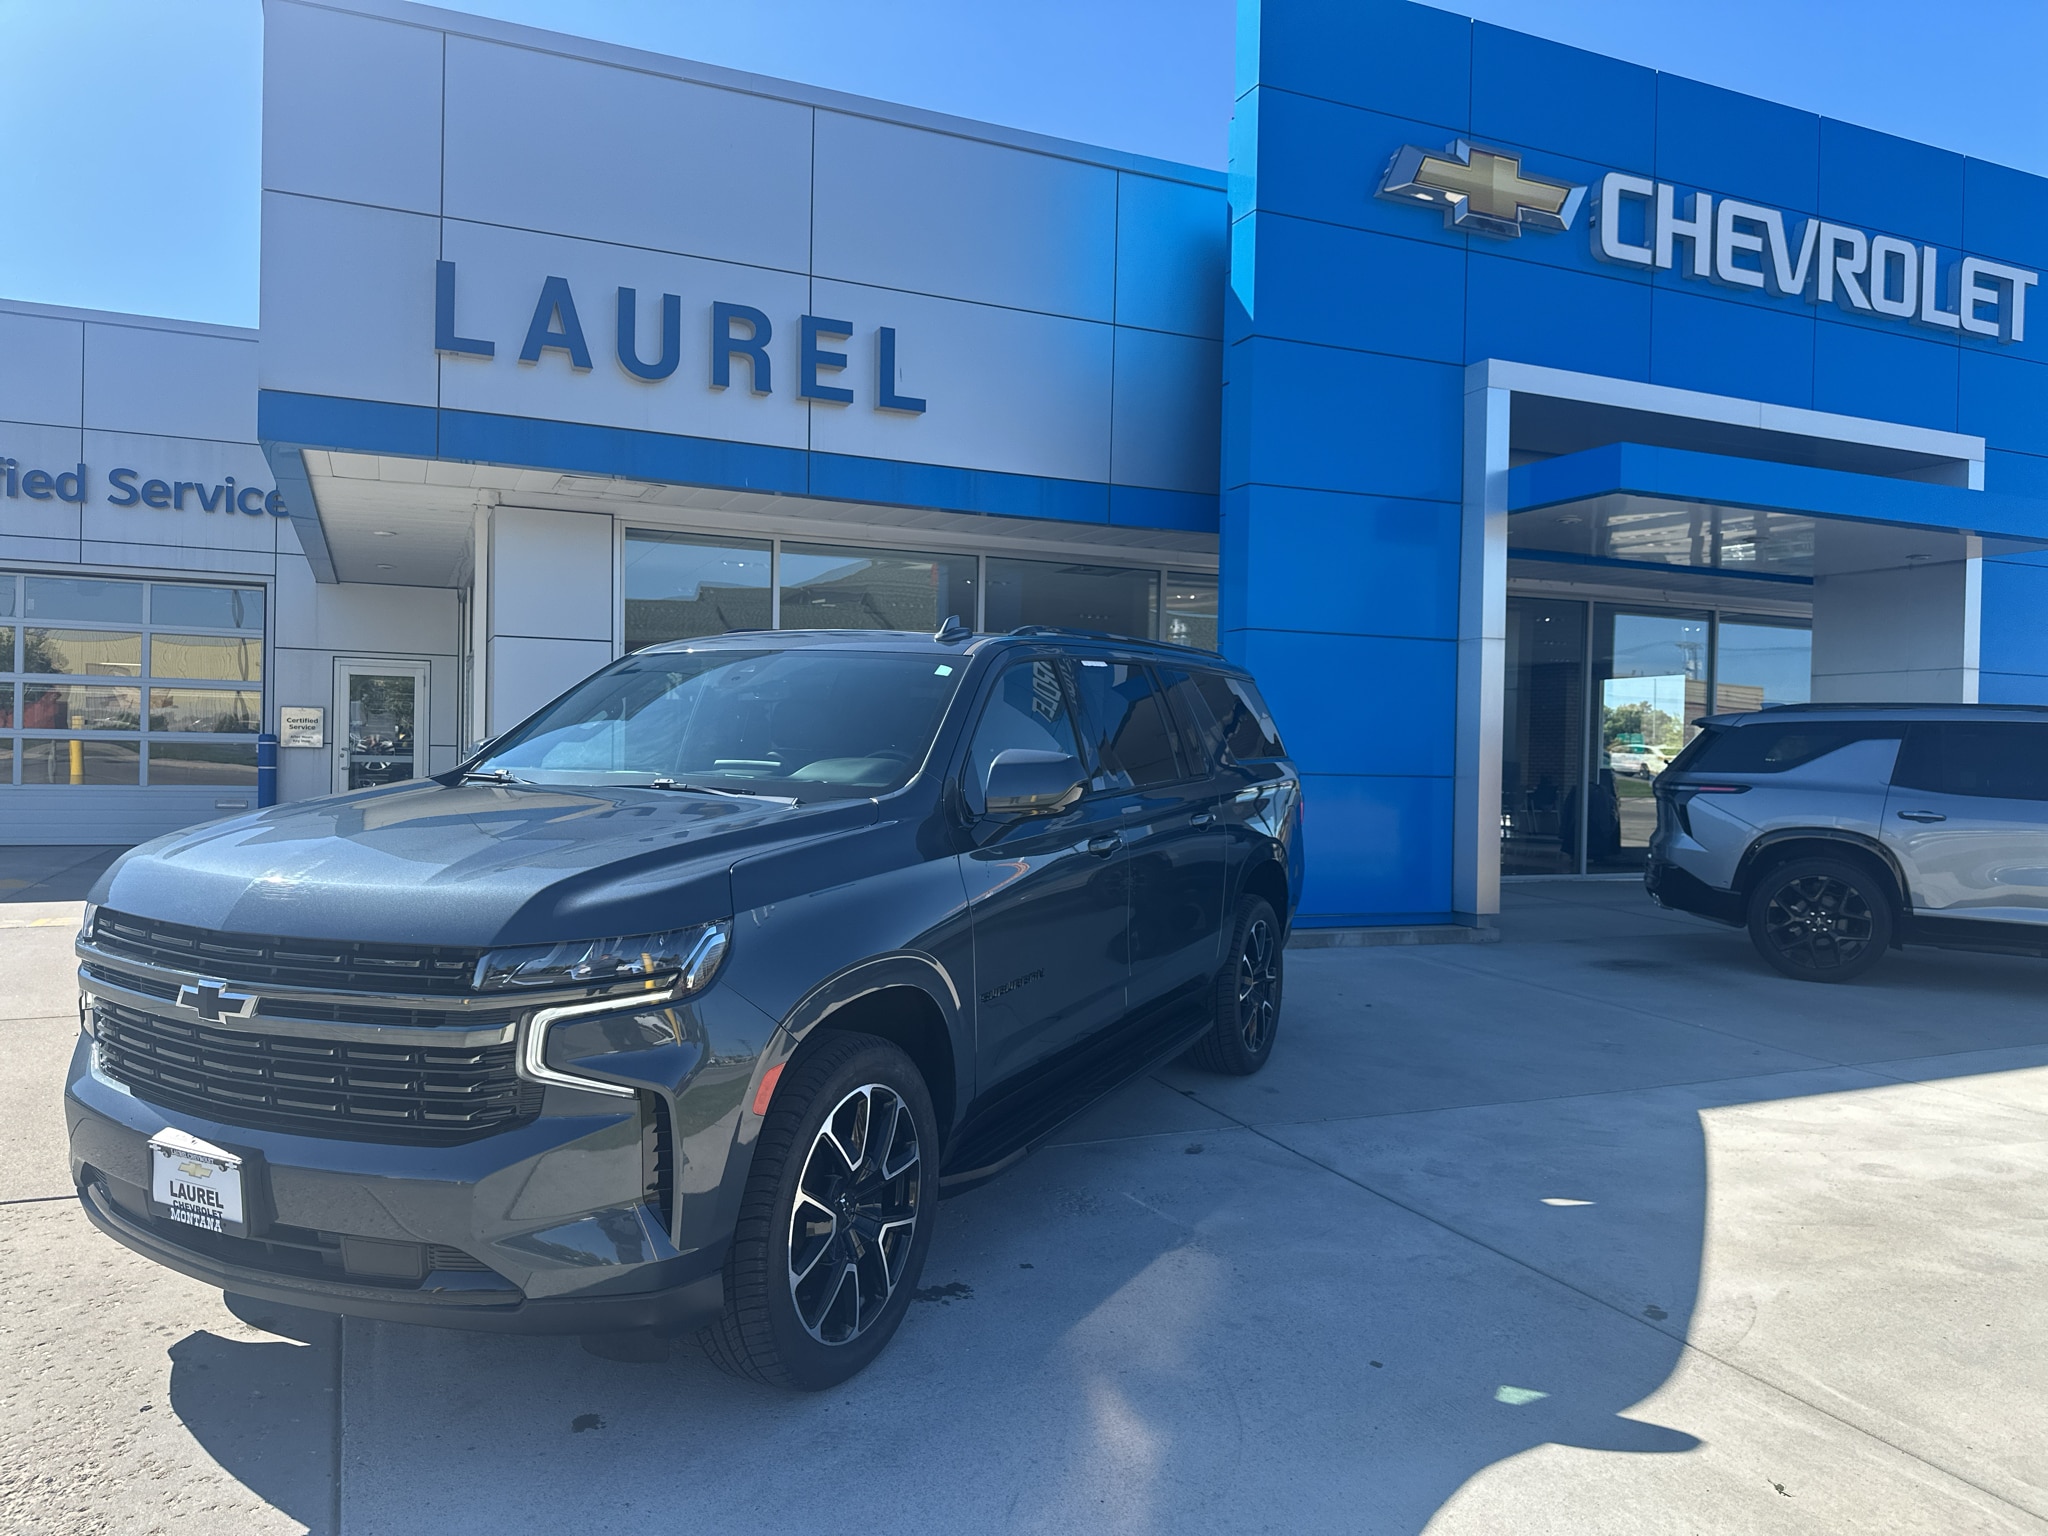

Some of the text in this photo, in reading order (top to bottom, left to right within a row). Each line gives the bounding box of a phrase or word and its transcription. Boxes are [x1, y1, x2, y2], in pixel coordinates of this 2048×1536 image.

[1592, 172, 2039, 343] CHEVROLET
[435, 259, 927, 416] LAUREL
[107, 467, 290, 517] Service
[170, 1180, 224, 1209] LAUREL
[173, 1200, 223, 1218] CHEVROLET
[170, 1207, 222, 1233] MONTANA
